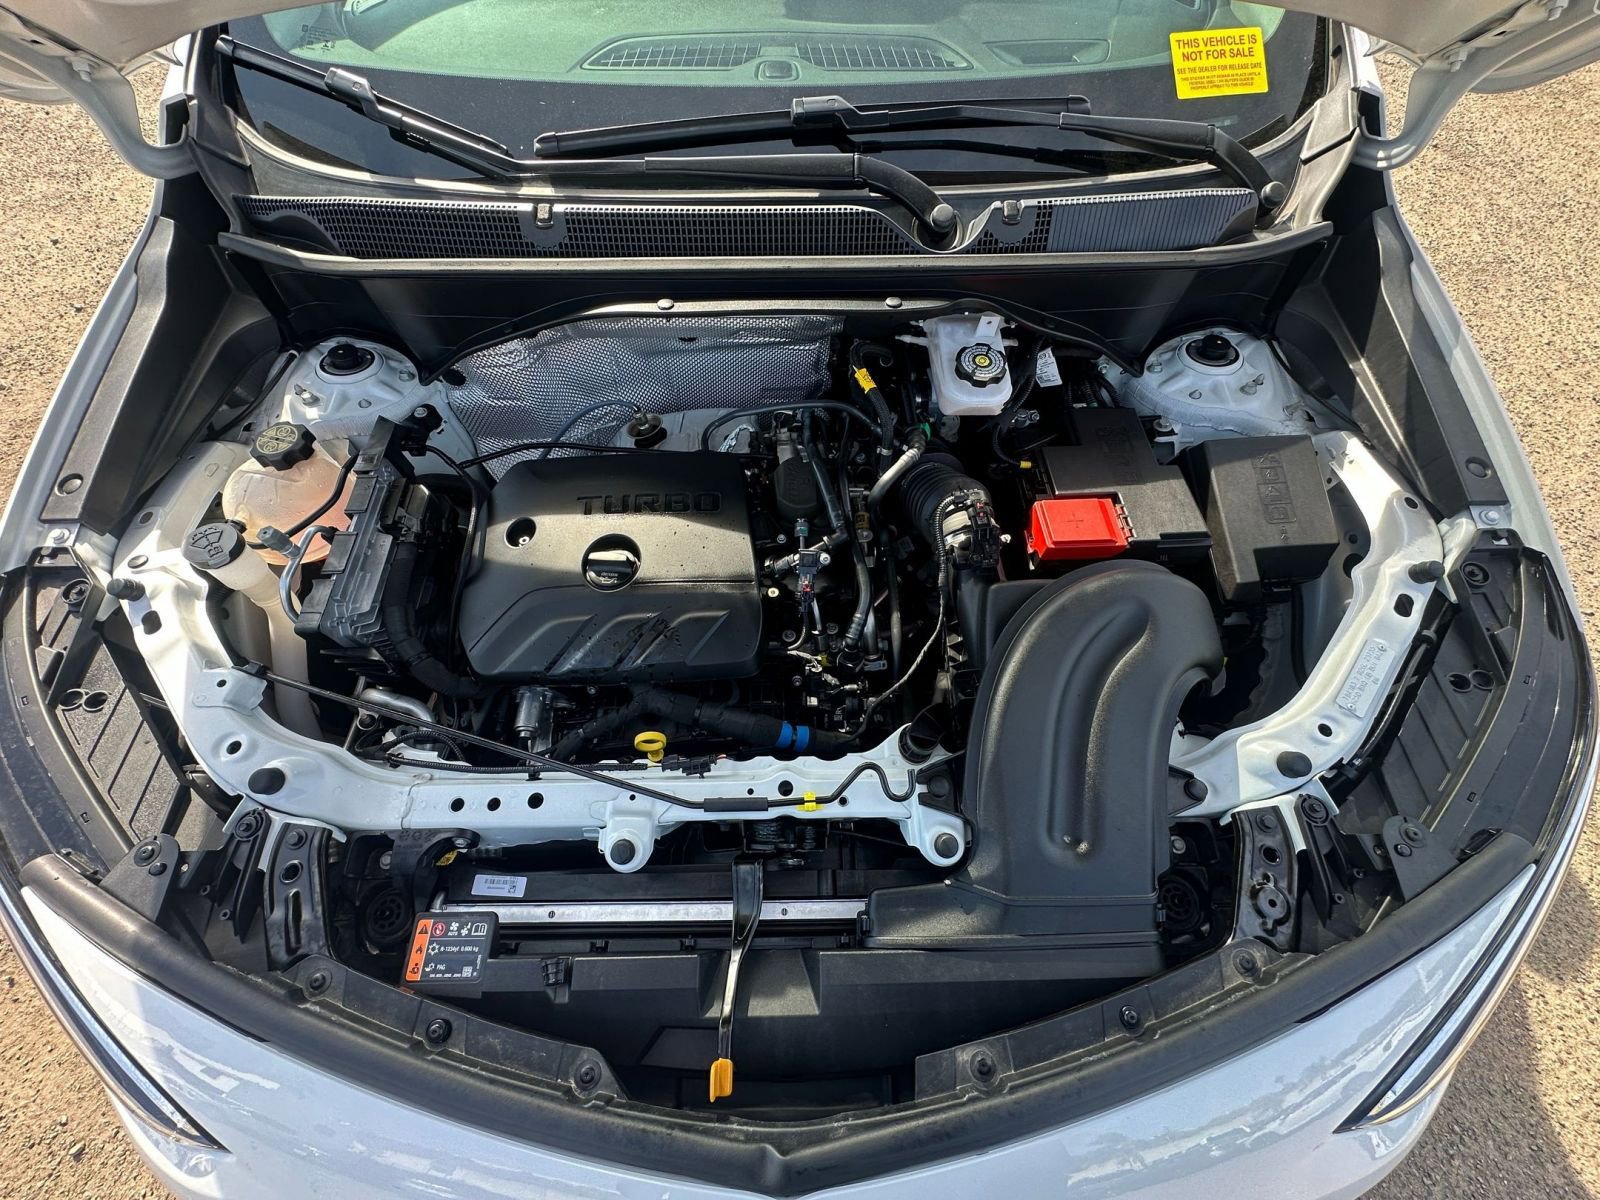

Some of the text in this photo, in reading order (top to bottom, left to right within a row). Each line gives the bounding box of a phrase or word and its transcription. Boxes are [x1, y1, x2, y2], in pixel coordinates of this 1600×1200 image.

[1176, 34, 1257, 49] THIS VEHICLE IS
[1182, 47, 1254, 62] NOT FOR SALE
[577, 493, 720, 515] TURBO
